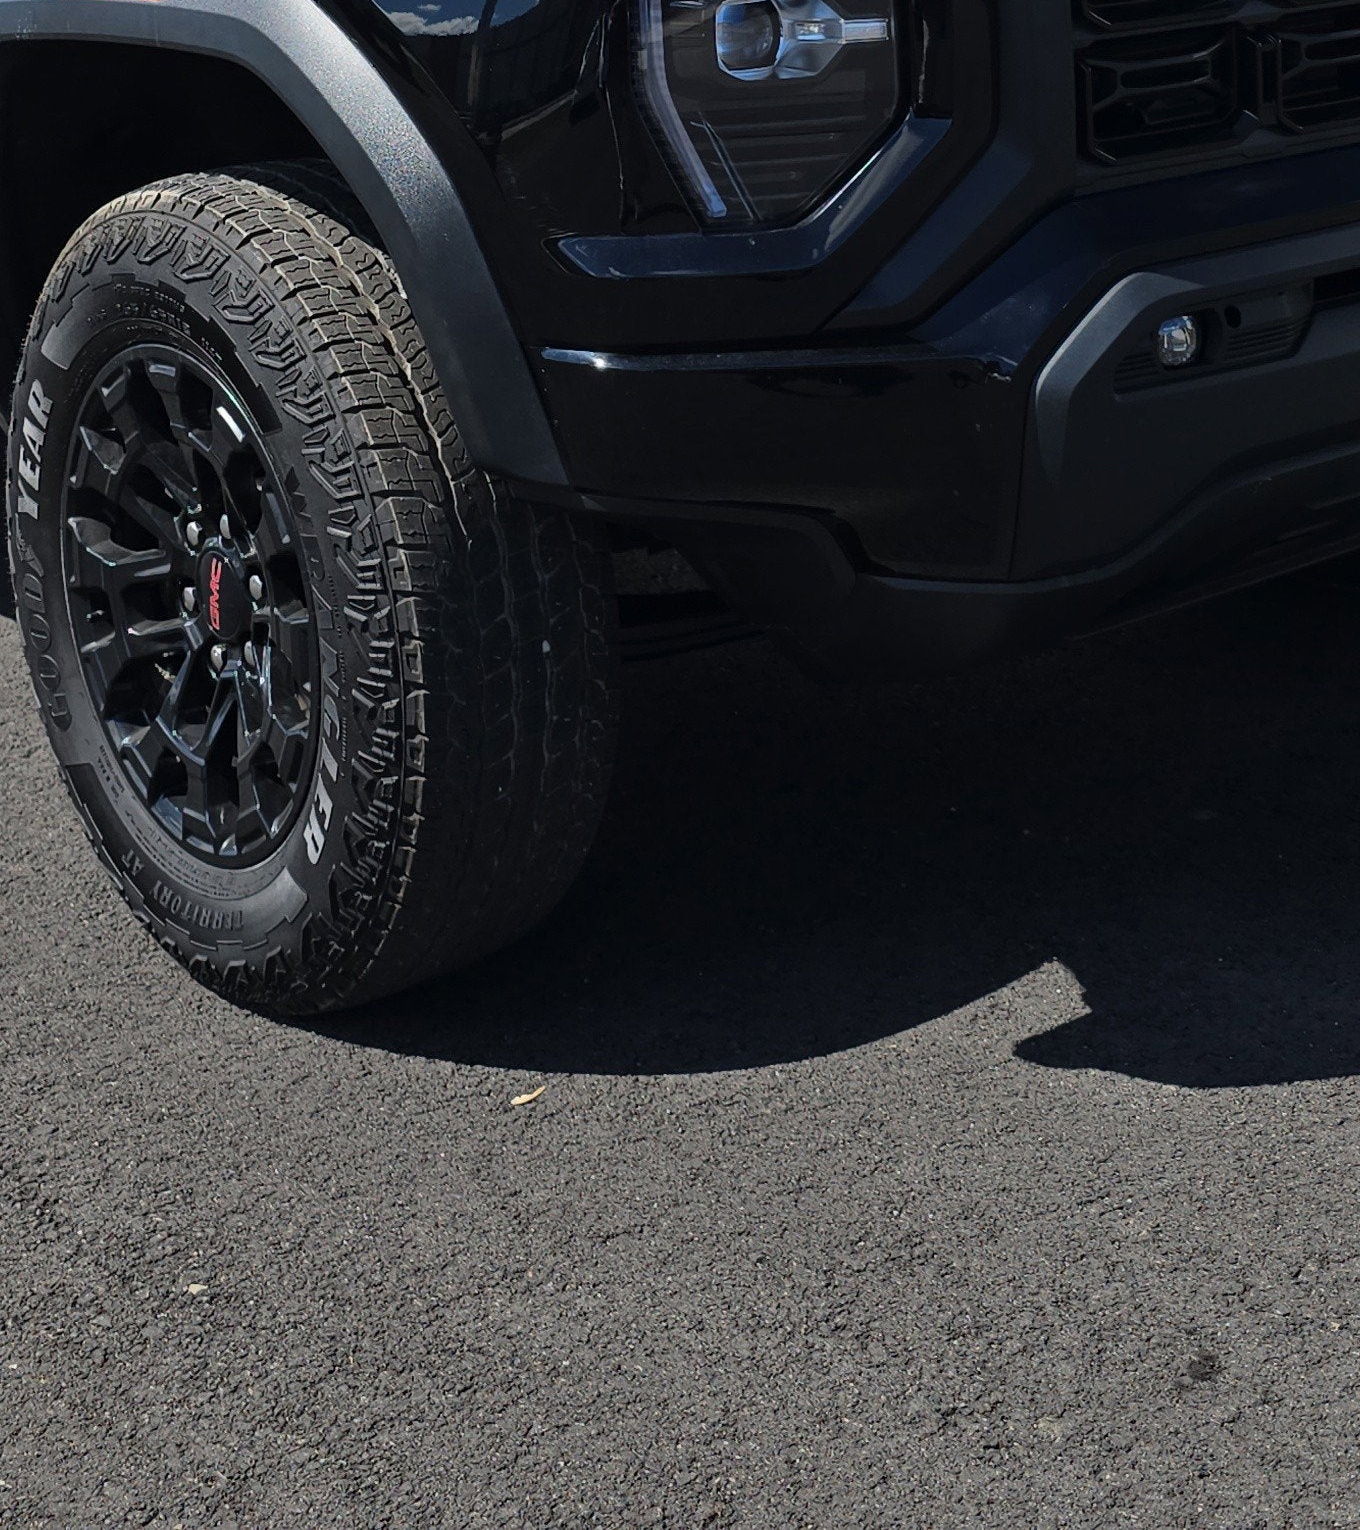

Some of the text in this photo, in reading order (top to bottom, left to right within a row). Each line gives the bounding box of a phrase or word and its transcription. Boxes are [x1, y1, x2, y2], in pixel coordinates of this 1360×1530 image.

[209, 556, 222, 631] GMC
[121, 849, 244, 931] TERRITORY AT
